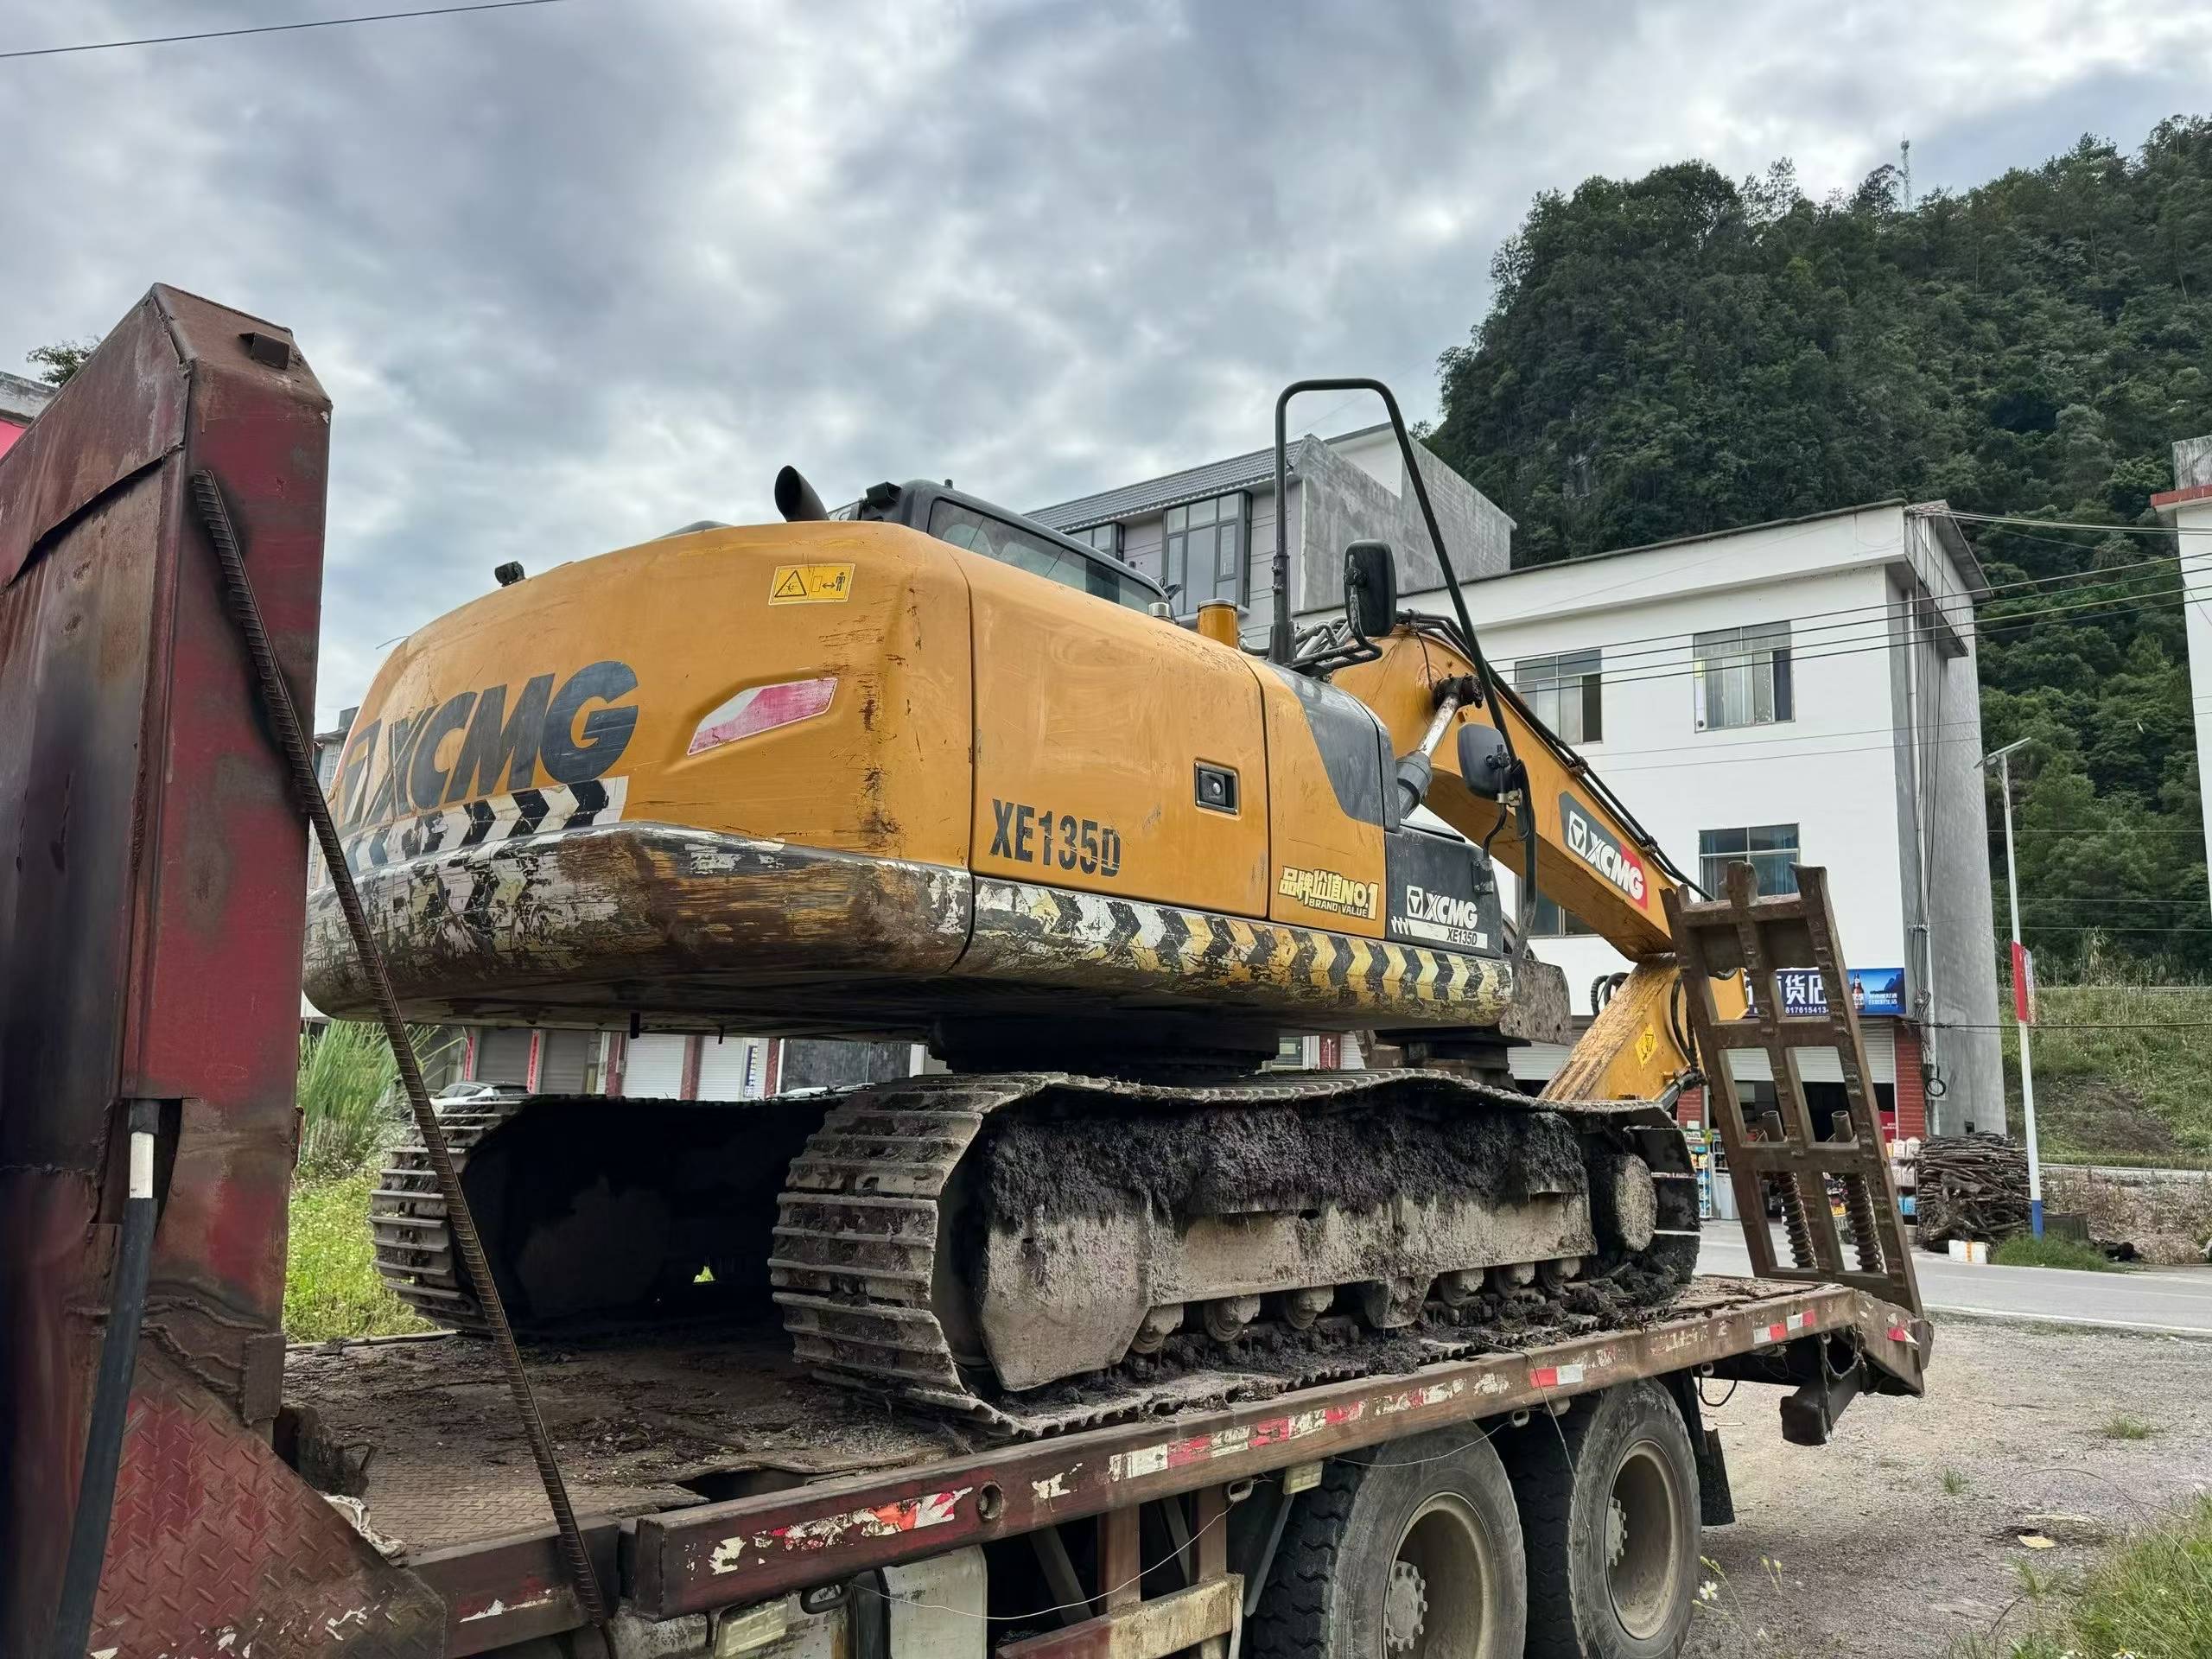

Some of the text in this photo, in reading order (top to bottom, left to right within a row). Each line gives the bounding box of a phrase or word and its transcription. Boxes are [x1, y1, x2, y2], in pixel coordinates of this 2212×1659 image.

[359, 660, 639, 828] XCMG
[988, 798, 1121, 877] XE135D
[1585, 830, 1643, 899] XCMG
[1309, 899, 1368, 917] BRAND VALUE
[1423, 893, 1478, 929] XCMG
[1446, 928, 1478, 946] XE135D
